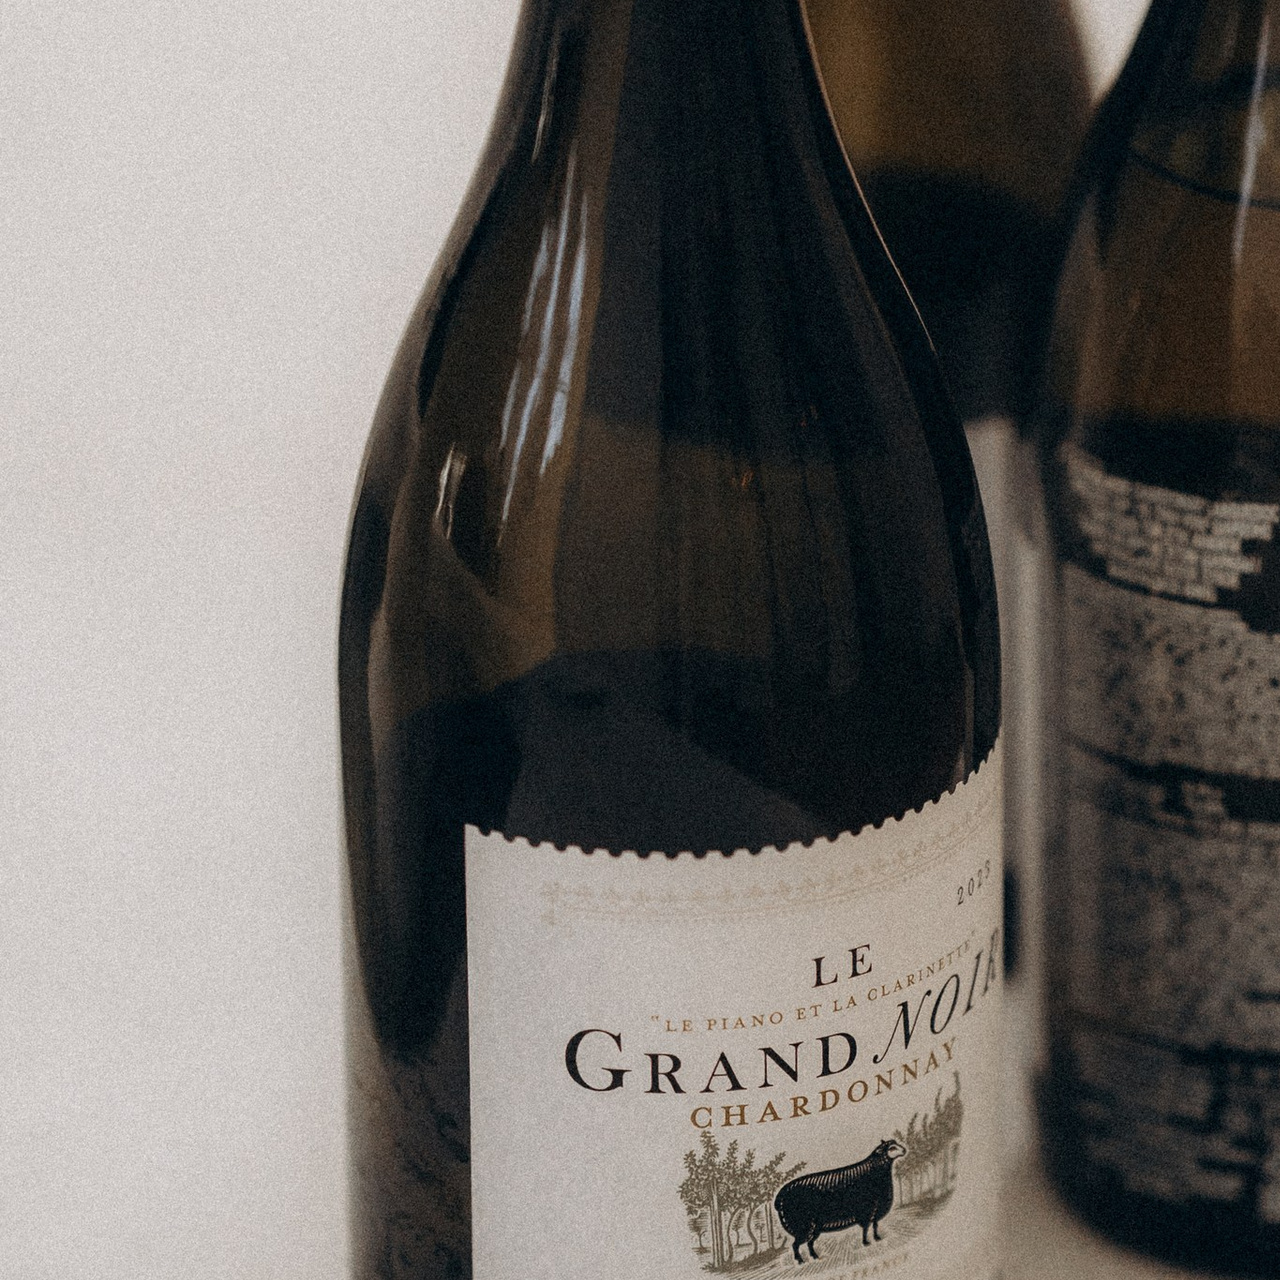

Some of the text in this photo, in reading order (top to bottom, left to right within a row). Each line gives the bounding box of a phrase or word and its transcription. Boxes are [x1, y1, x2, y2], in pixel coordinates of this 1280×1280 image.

[811, 943, 874, 988] LE
[565, 927, 998, 1095] GRAND NOIR
[707, 1011, 784, 1031] PIANO
[796, 1004, 823, 1021] ET
[832, 995, 858, 1013] LA
[690, 1036, 957, 1129] CHARDONNAY
